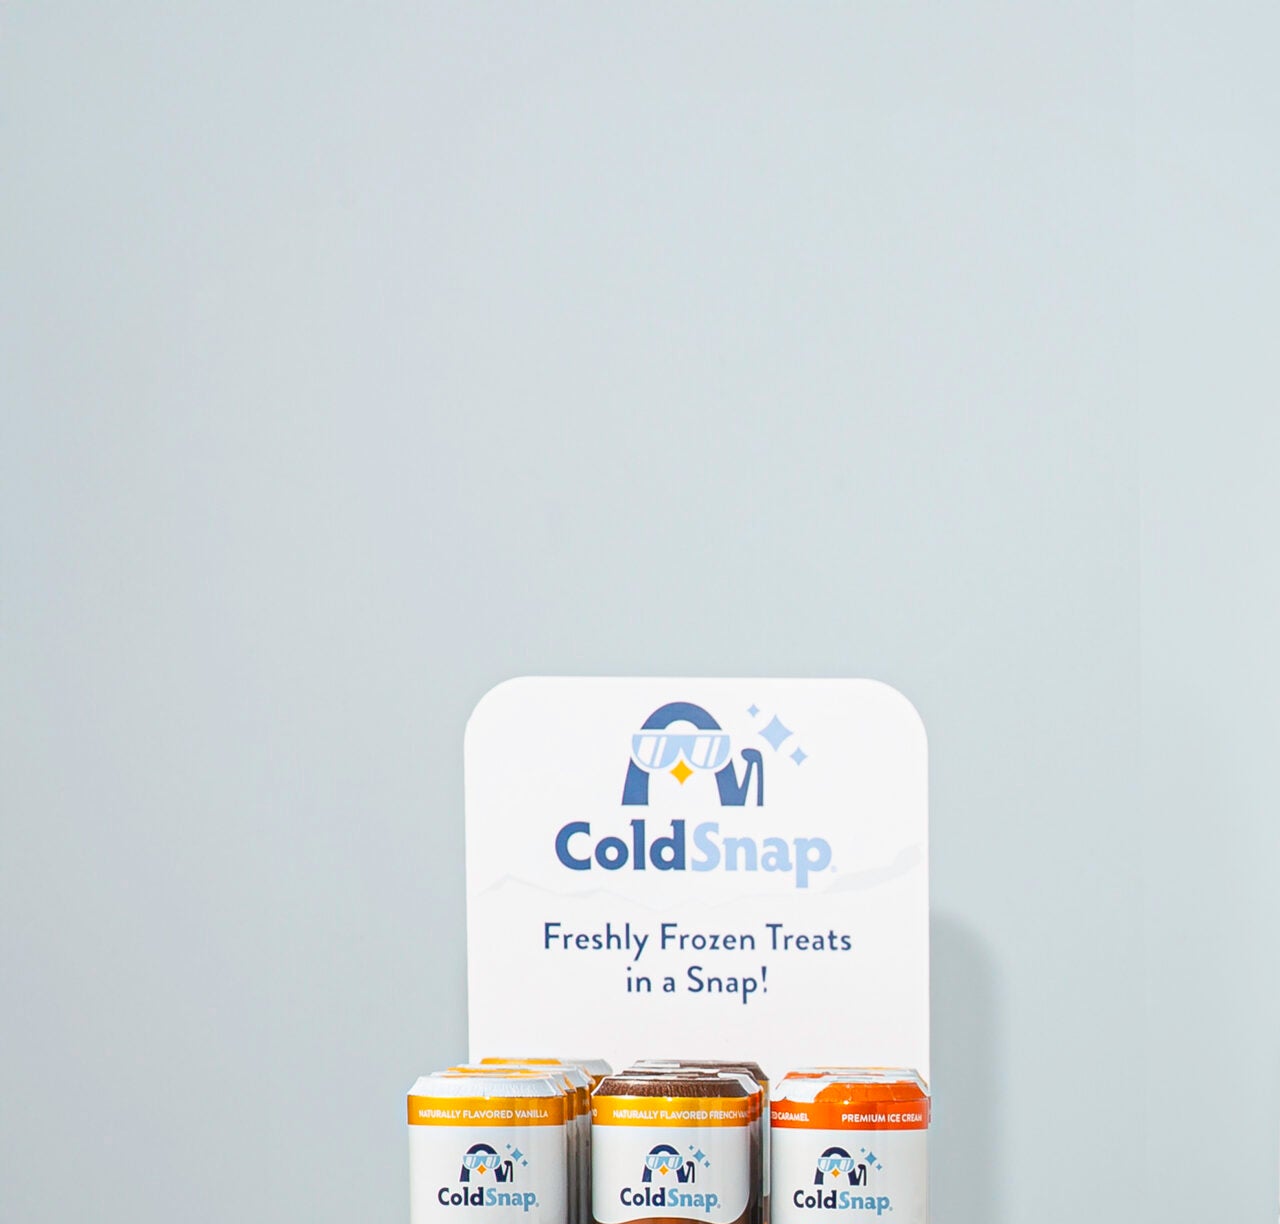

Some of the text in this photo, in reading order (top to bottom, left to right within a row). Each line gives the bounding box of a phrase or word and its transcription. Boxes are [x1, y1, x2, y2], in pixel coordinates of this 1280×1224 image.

[554, 818, 832, 889] ColdSnap
[543, 922, 853, 962] Freshly Frozen Treats
[626, 966, 769, 1005] in a Snap!
[418, 1109, 549, 1119] NATURALLY FLAVORED VANILLA
[612, 1109, 659, 1120] NATURALLY
[660, 1110, 708, 1120] FLAVORED
[709, 1110, 738, 1119] FRENCH
[777, 1111, 810, 1122] CARAMEL
[841, 1113, 923, 1123] PREMIUM ICE CREAM
[437, 1186, 537, 1212] ColdSnap
[620, 1187, 718, 1213] ColdSnap
[793, 1189, 890, 1216] ColdSnap
